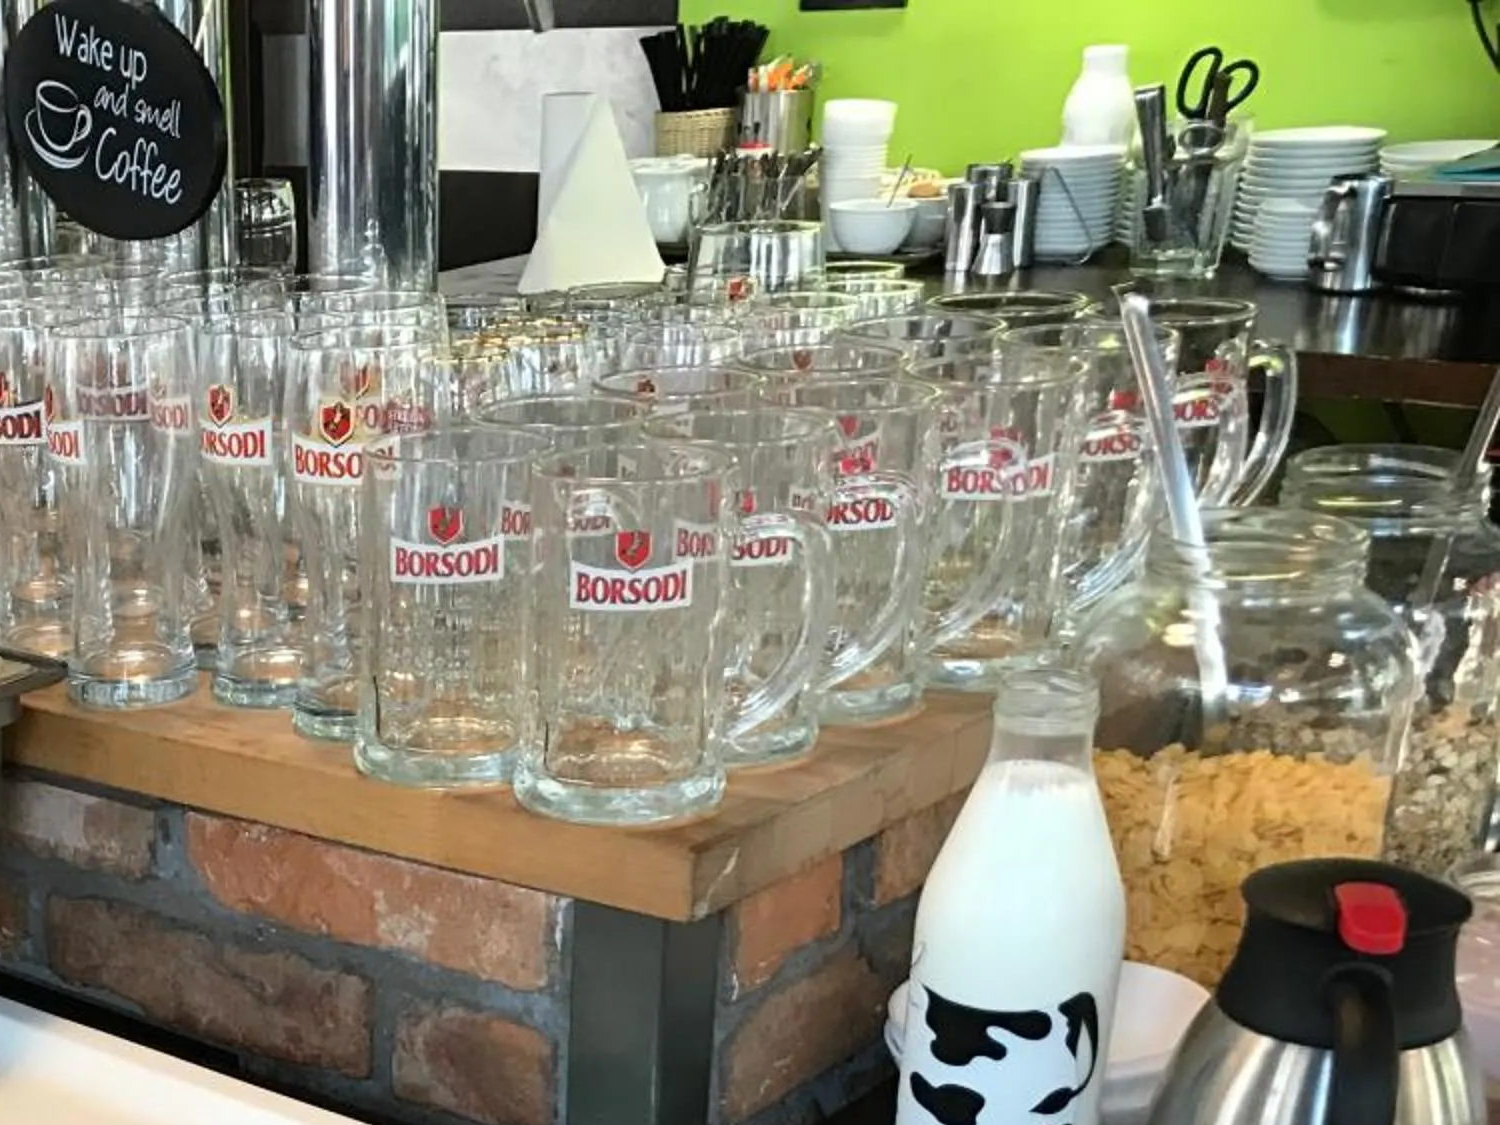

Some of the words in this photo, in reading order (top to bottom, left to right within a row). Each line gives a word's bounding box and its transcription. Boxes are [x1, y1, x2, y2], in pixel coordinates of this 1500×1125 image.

[55, 13, 113, 71] Wake
[119, 48, 148, 90] up
[93, 83, 130, 117] and
[134, 99, 182, 139] smell
[95, 127, 184, 205] Coffee
[154, 402, 189, 429] SODI
[47, 429, 80, 459] SODI
[294, 444, 364, 478] BORSO
[826, 498, 894, 525] RSOD
[395, 544, 498, 578] BORSODI
[731, 537, 788, 561] SODI
[576, 570, 688, 605] BORSODI
